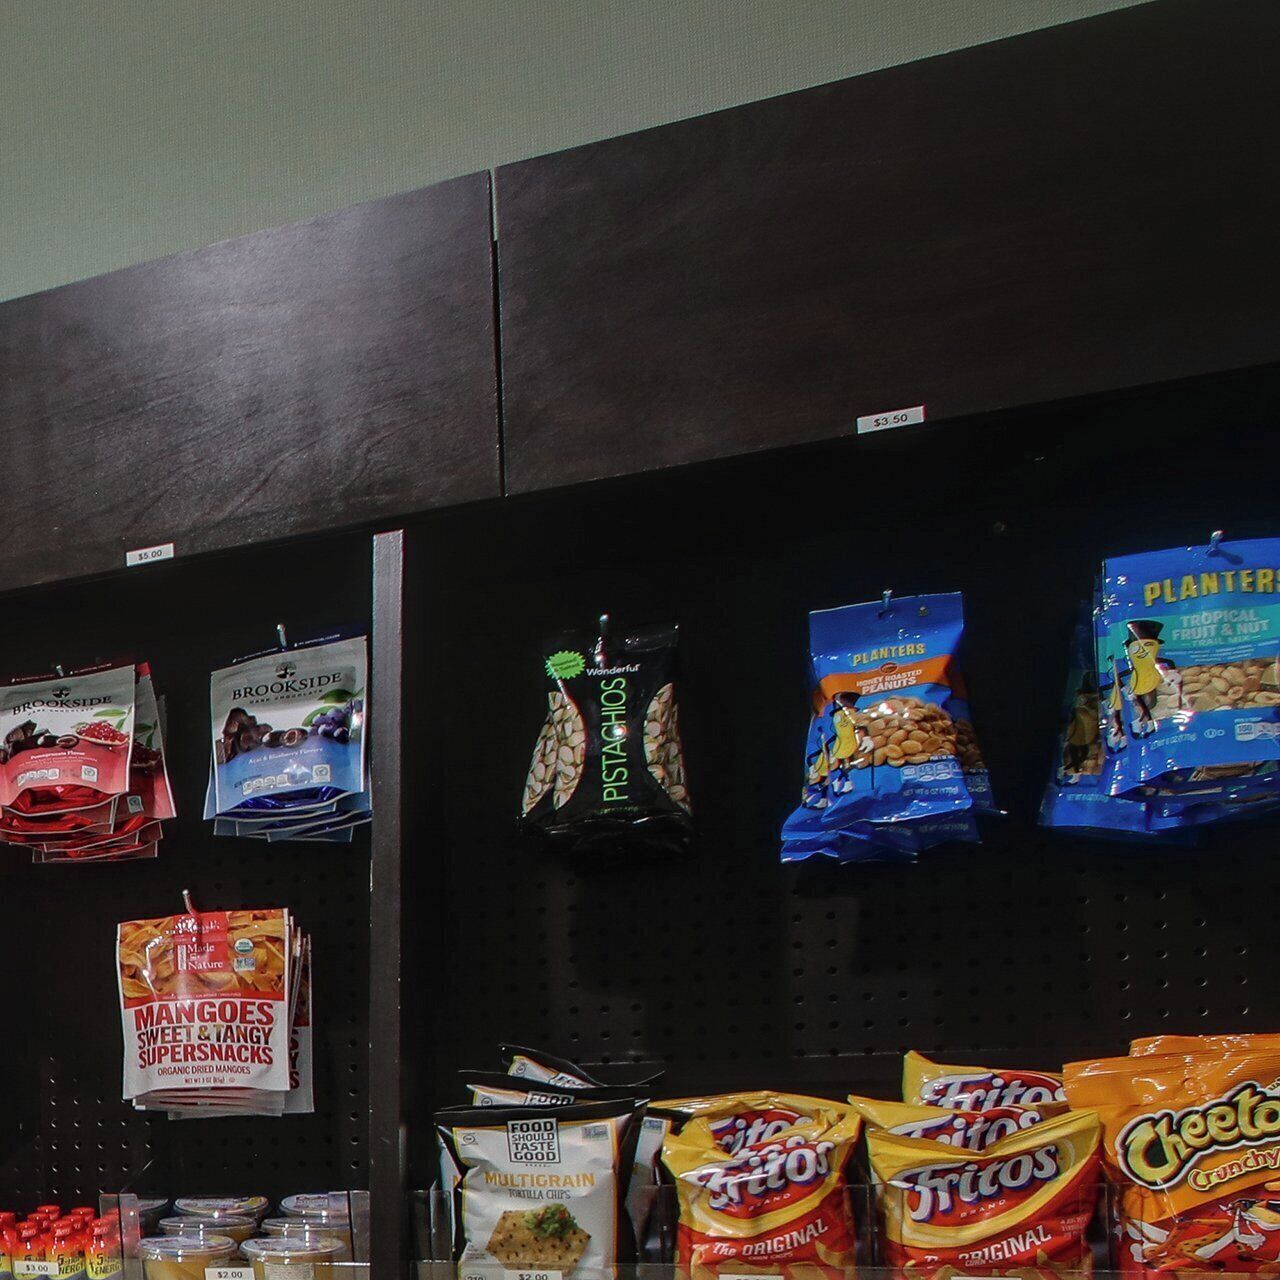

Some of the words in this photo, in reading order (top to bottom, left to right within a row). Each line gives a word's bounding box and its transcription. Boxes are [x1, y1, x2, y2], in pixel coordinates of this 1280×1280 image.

[873, 413, 909, 427] $3.50
[138, 549, 163, 561] $5.00
[1180, 608, 1260, 628] TROPICAL
[1172, 624, 1218, 640] FRUIT
[1222, 624, 1232, 635] &
[1237, 620, 1269, 635] NUT
[852, 643, 926, 667] PLANTERS
[586, 663, 641, 677] Wonderful
[856, 676, 883, 687] HONEY
[885, 669, 923, 682] ROASTED
[232, 672, 342, 700] BROOKSIDE
[862, 677, 917, 694] PEANUTS
[12, 696, 112, 715] BROOKSIDE
[600, 676, 629, 802] PISTACHIOS
[188, 960, 224, 970] Nature
[134, 1000, 274, 1032] MANGOES
[137, 1025, 194, 1049] SWEET
[198, 1025, 210, 1041] &
[215, 1025, 273, 1045] TANGY
[139, 1044, 273, 1069] SUPERSNACKS
[158, 1066, 190, 1077] ORGANIC
[192, 1066, 214, 1074] DRIED
[215, 1065, 251, 1074] MANGOES
[511, 1120, 554, 1133] FOOD
[511, 1133, 555, 1142] SHOULD
[513, 1142, 556, 1151] TASTE
[514, 1151, 556, 1161] GOOD
[485, 1171, 596, 1188] MULTIGRAIN
[679, 1141, 837, 1211] Fritos
[889, 1141, 1061, 1224] Fritos
[508, 1189, 544, 1199] TORTILLA
[546, 1189, 572, 1200] CHIPS
[711, 1242, 738, 1257] The
[741, 1222, 830, 1258] ORIGINAL
[26, 1264, 49, 1272] $3.00
[216, 1269, 243, 1280] $2.00
